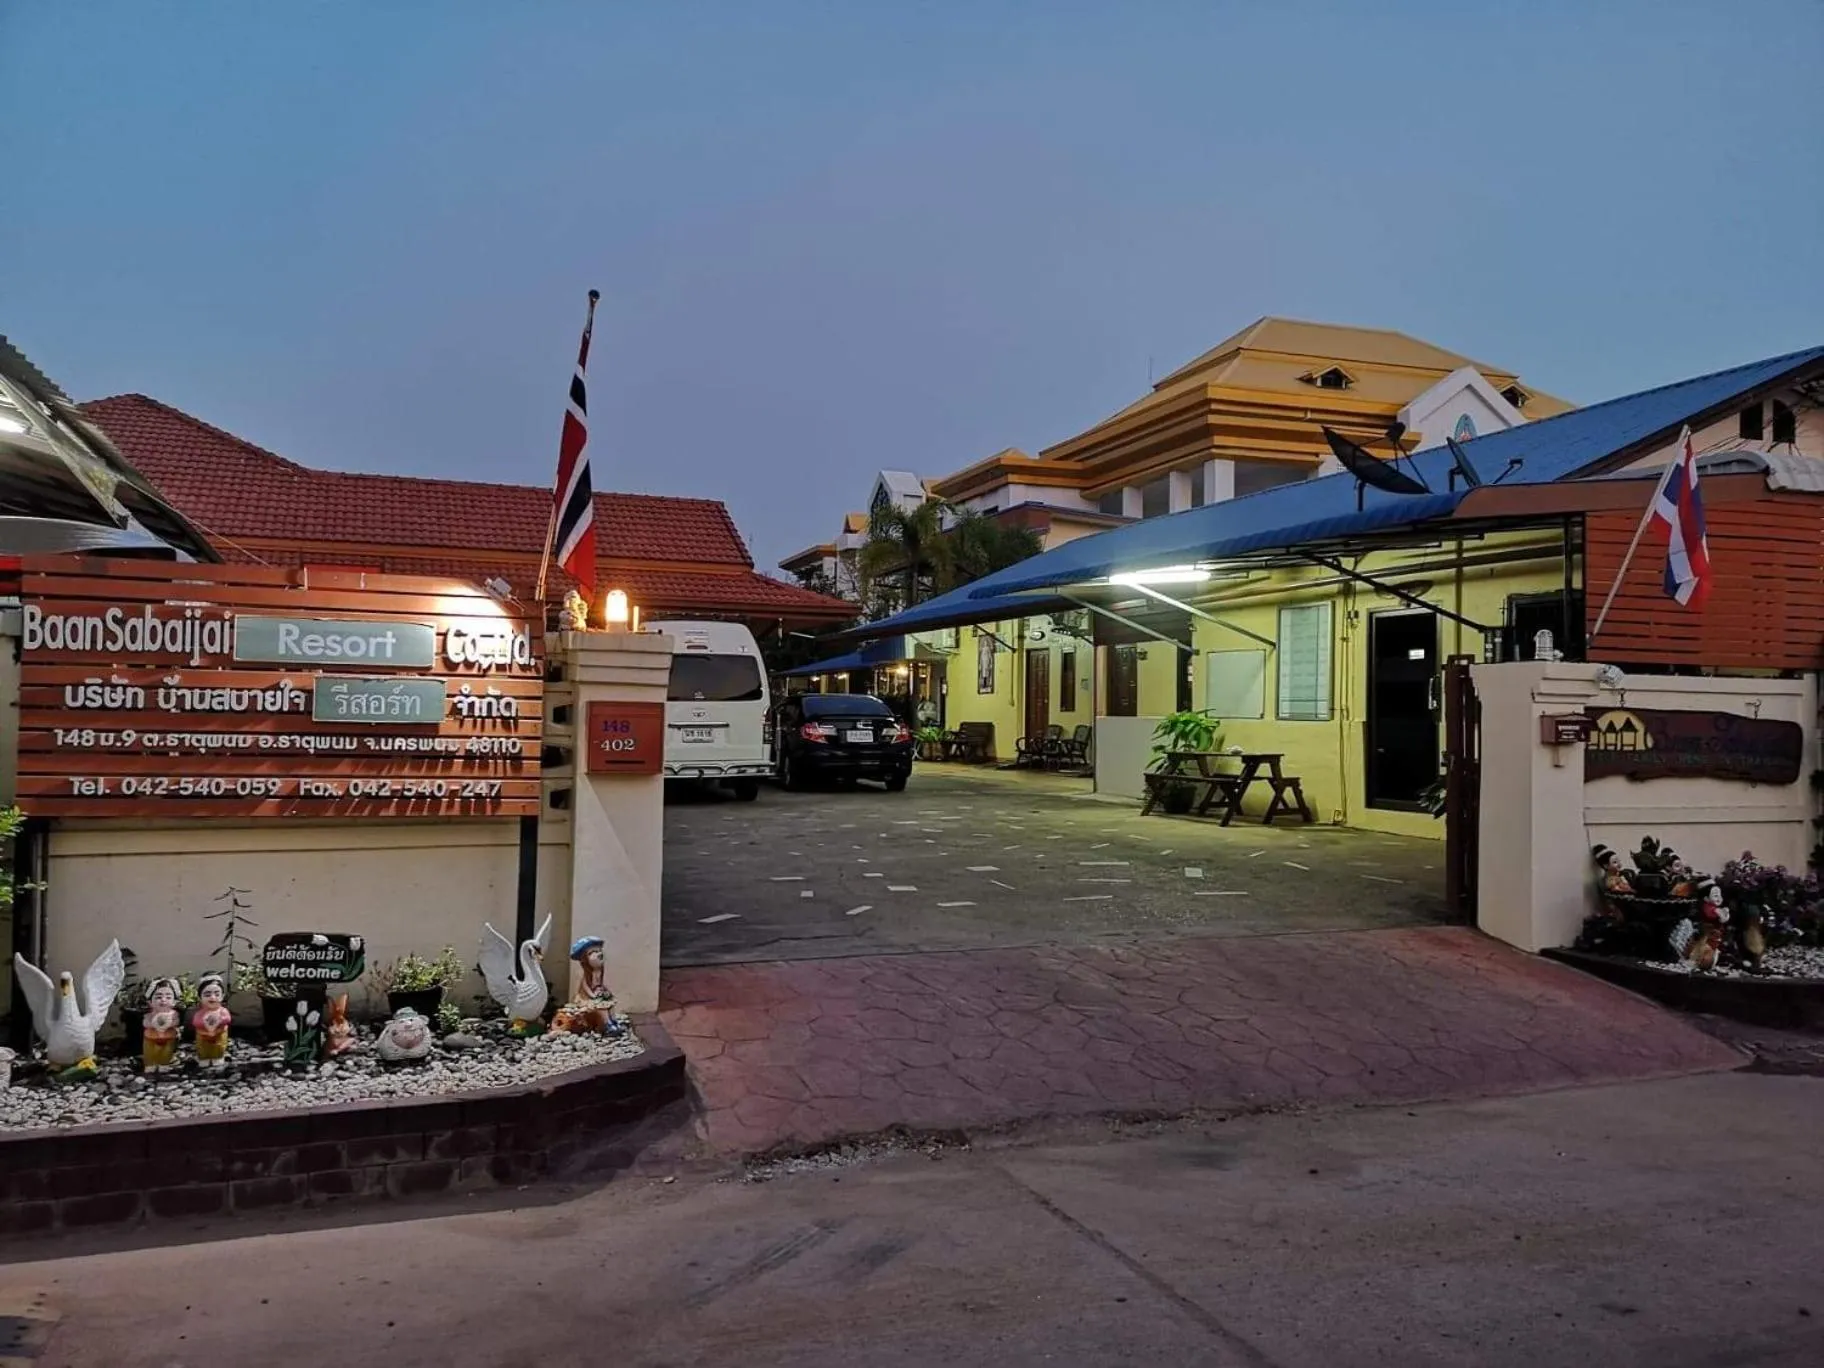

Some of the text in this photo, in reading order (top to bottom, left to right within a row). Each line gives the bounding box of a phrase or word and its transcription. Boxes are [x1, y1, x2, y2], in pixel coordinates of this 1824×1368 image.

[278, 622, 397, 658] Resort
[65, 675, 145, 709] บริษัท
[330, 683, 422, 717] รีสอร์ท
[452, 683, 518, 719] จำกัด
[53, 728, 95, 746] 148
[466, 736, 521, 753] 48110
[600, 738, 636, 752] 402
[69, 776, 502, 797] Tel. 042-540-059 Fax. 042-540-247
[266, 943, 345, 961] ยินดีต้อนรับ
[266, 963, 341, 979] welcome
